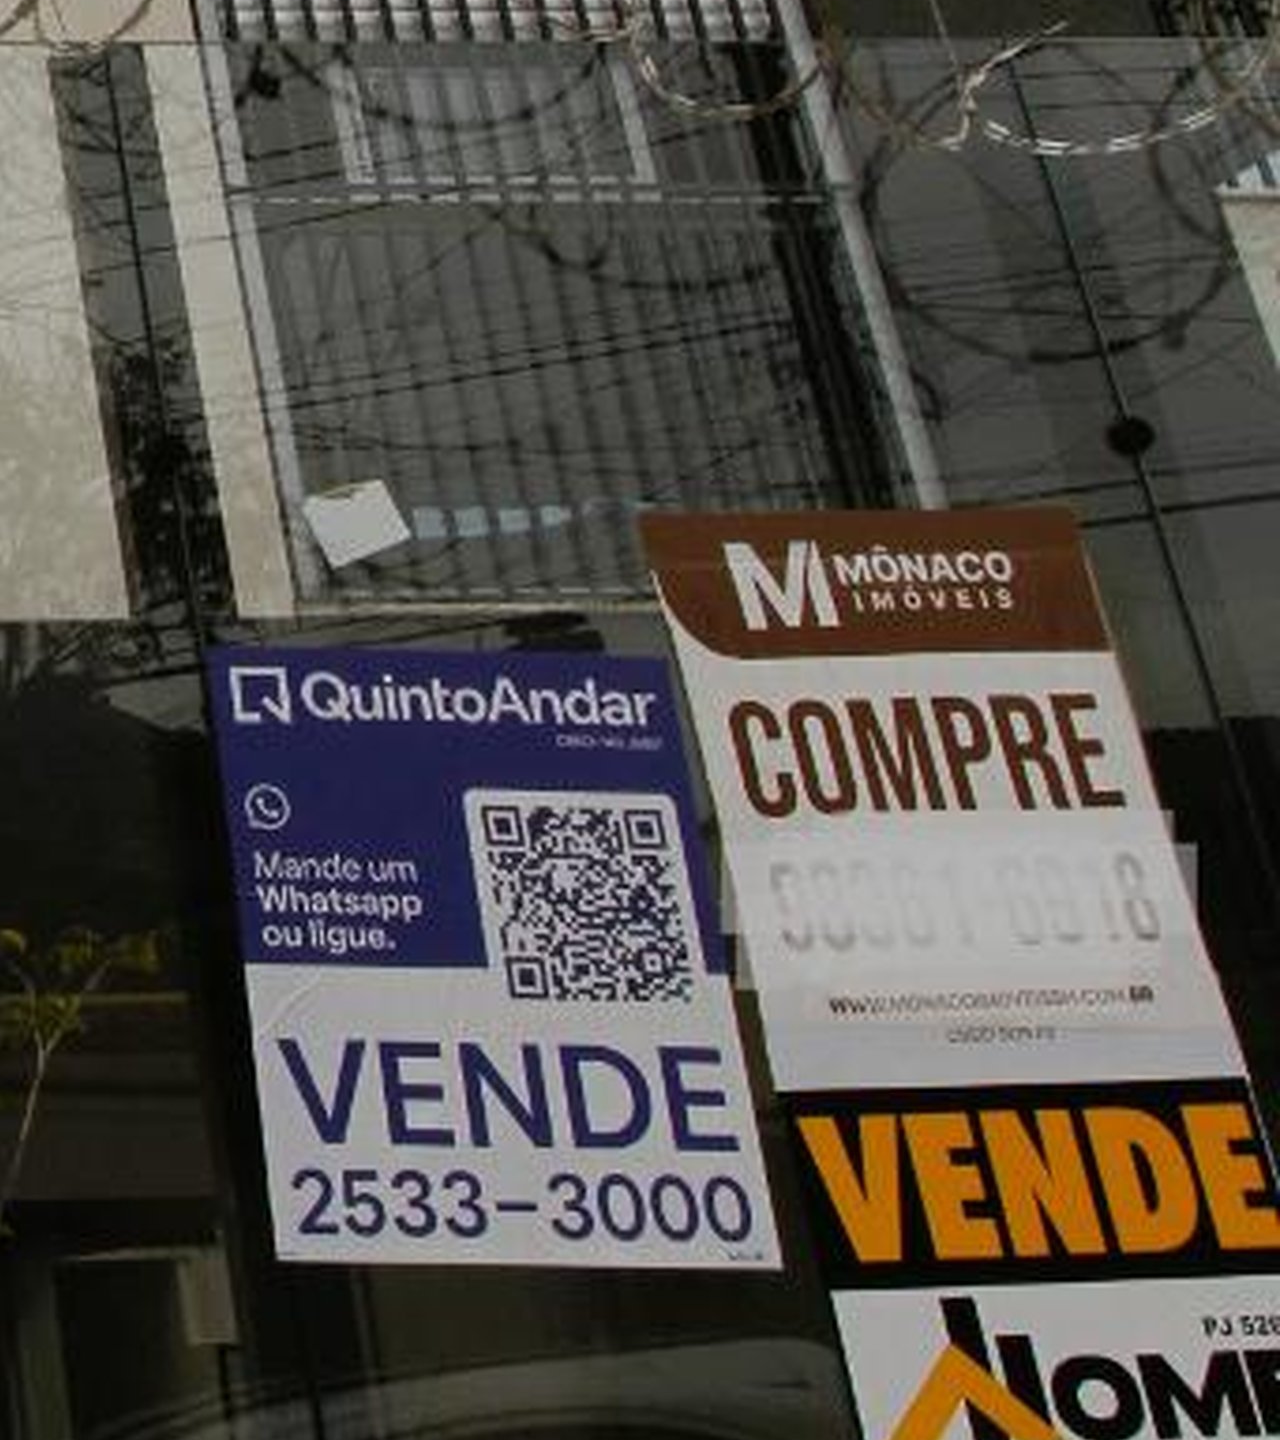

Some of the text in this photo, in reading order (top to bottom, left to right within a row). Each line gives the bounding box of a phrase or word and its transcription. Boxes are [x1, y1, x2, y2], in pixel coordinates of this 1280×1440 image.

[833, 545, 1013, 586] MÔNACO
[853, 586, 1016, 612] IMÓVEIS
[299, 670, 656, 727] QuintoAndar
[727, 693, 1126, 818] COMPRE
[252, 850, 419, 883] Mande um
[257, 885, 424, 920] Whatsapp
[262, 919, 397, 954] ou ligue.
[277, 1037, 741, 1153] VENDE
[797, 1102, 1280, 1265] VENDE
[291, 1168, 754, 1242] 2533-3000
[1201, 1316, 1234, 1337] PJ
